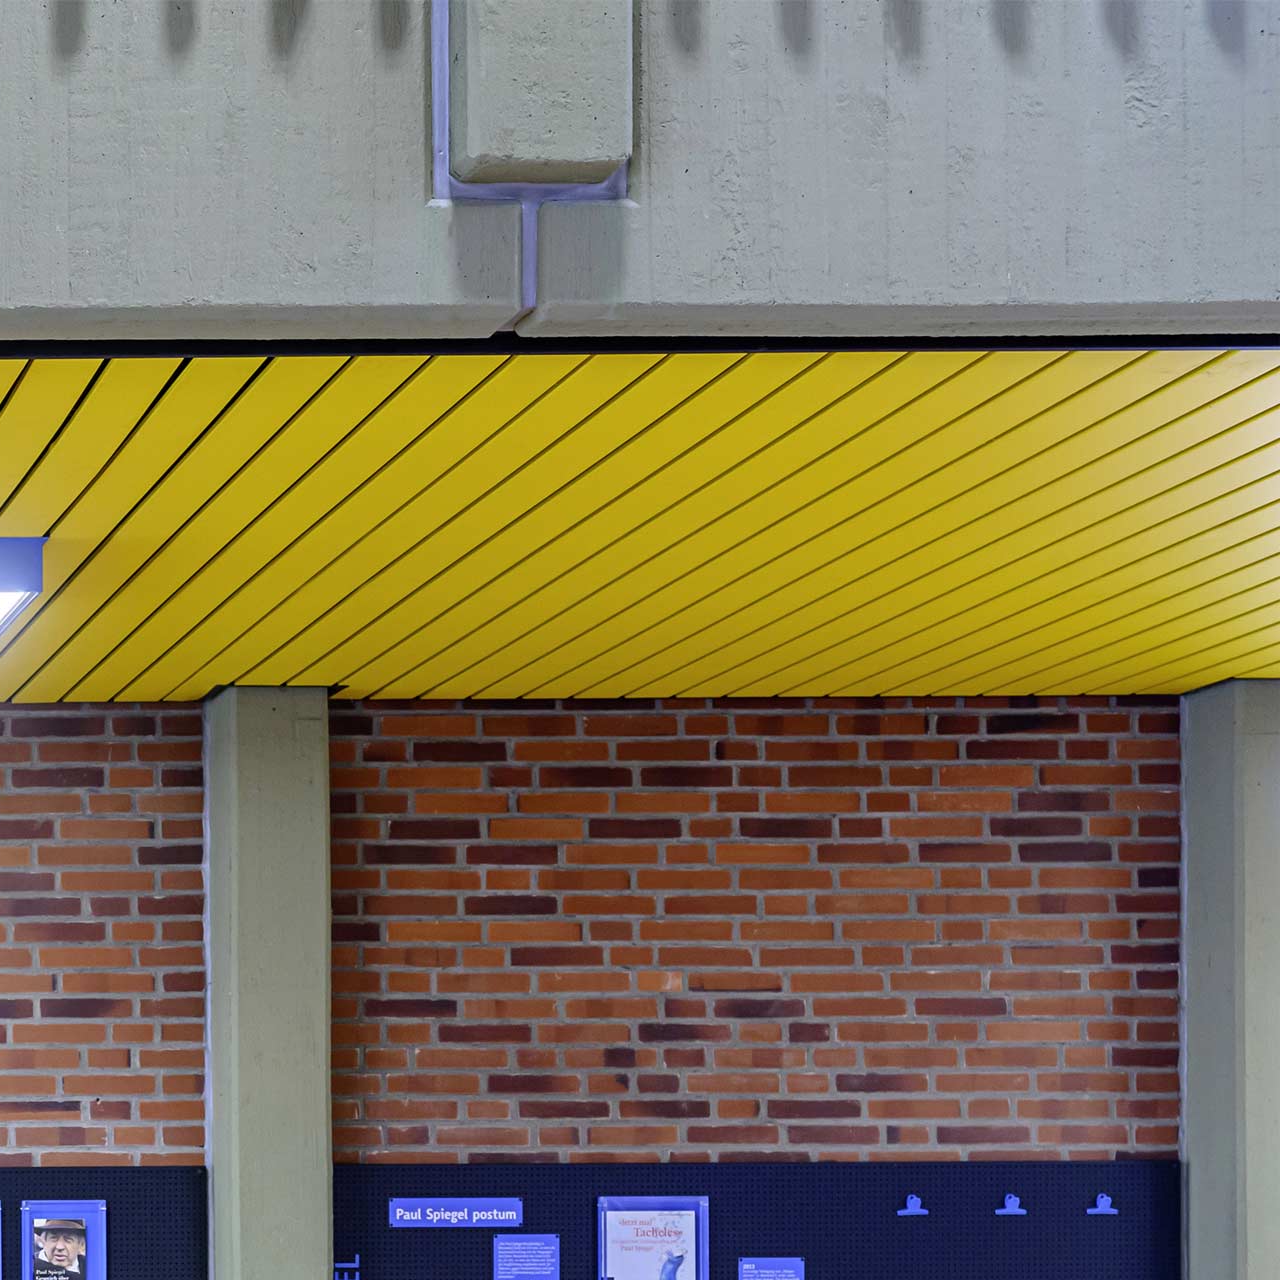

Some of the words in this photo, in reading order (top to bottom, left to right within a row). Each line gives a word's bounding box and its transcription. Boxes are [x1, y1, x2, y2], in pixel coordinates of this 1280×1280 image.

[395, 1208, 422, 1220] Paul
[426, 1208, 468, 1223] Spiegel
[472, 1209, 517, 1222] postum
